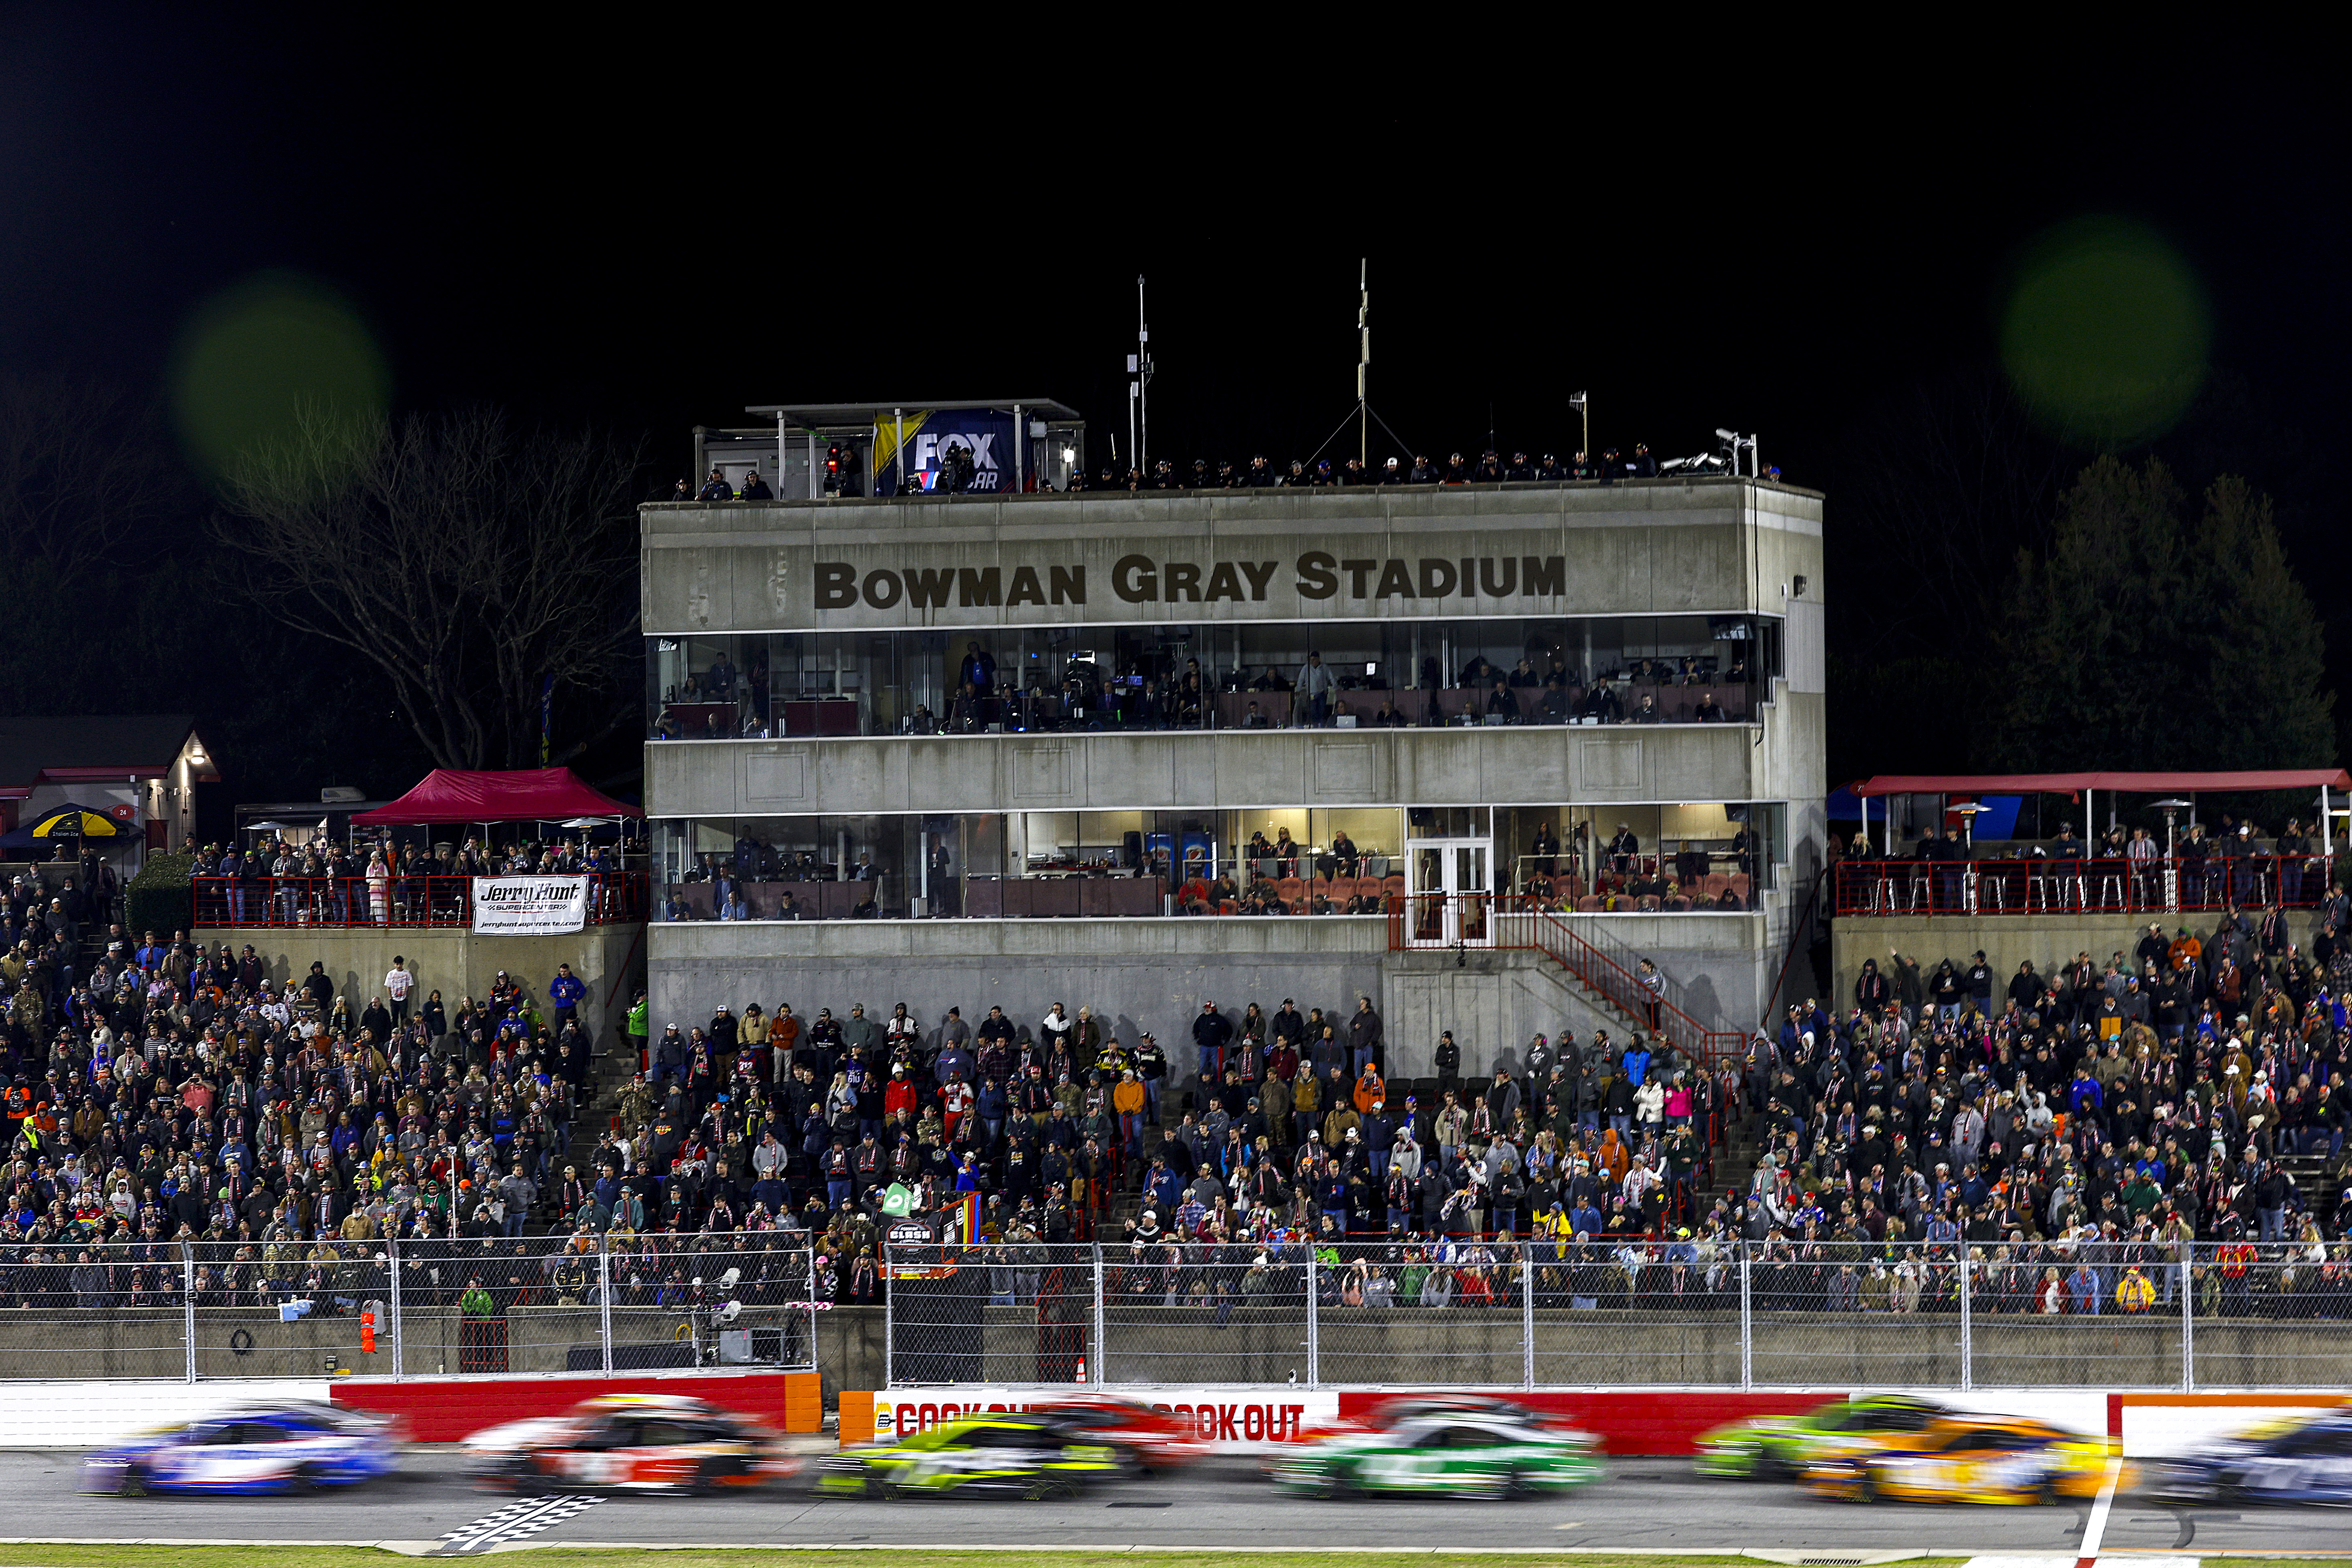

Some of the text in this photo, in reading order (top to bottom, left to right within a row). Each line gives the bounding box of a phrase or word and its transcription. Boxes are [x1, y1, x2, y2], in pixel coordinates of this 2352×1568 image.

[814, 550, 1566, 608] BOWMAN GRAY STADIUM
[481, 883, 580, 904] Jerry Hunt
[890, 1231, 930, 1239] CLASH
[1152, 1404, 1304, 1442] OOK OUT
